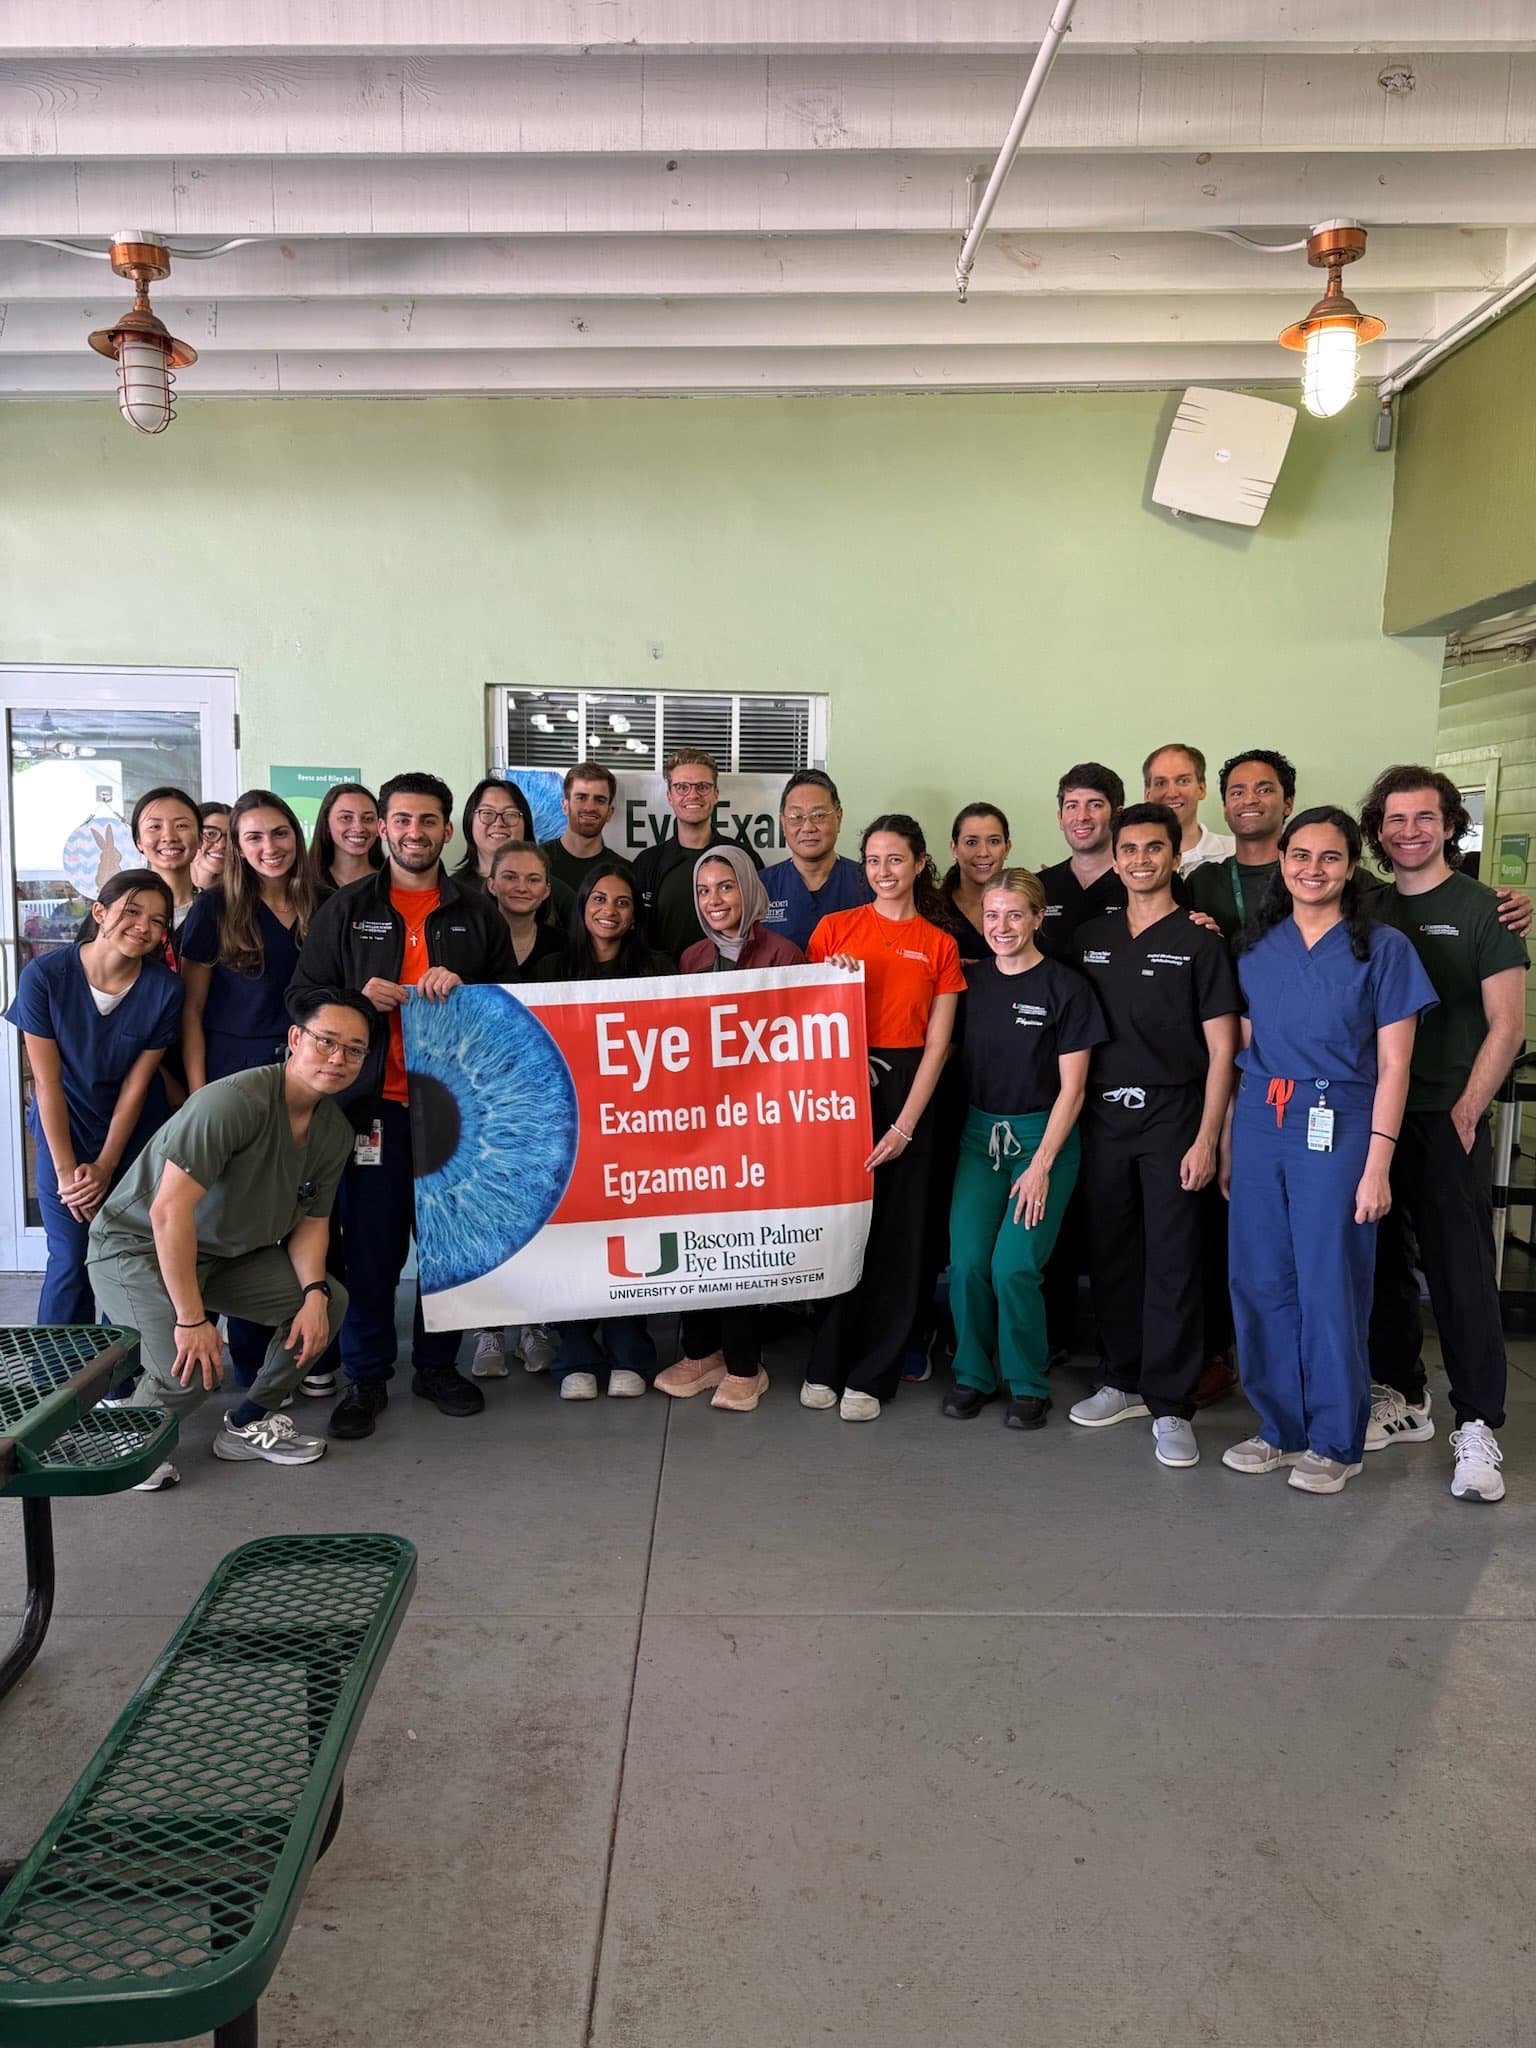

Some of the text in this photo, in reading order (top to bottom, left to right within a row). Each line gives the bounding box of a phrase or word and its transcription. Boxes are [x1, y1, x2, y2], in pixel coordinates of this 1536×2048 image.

[626, 800, 786, 849] Ey Exa
[768, 899, 788, 908] scom
[595, 1003, 850, 1092] Eye Exam
[600, 1089, 856, 1135] Examen de la Vista
[603, 1154, 766, 1205] Egzamen Je
[607, 1231, 680, 1278] U
[684, 1224, 824, 1250] Bascom Palmer
[609, 1272, 825, 1300] UNIVERSITY OF MIAMI HEALTH SYSTEM
[685, 1249, 797, 1277] Eye Institute
